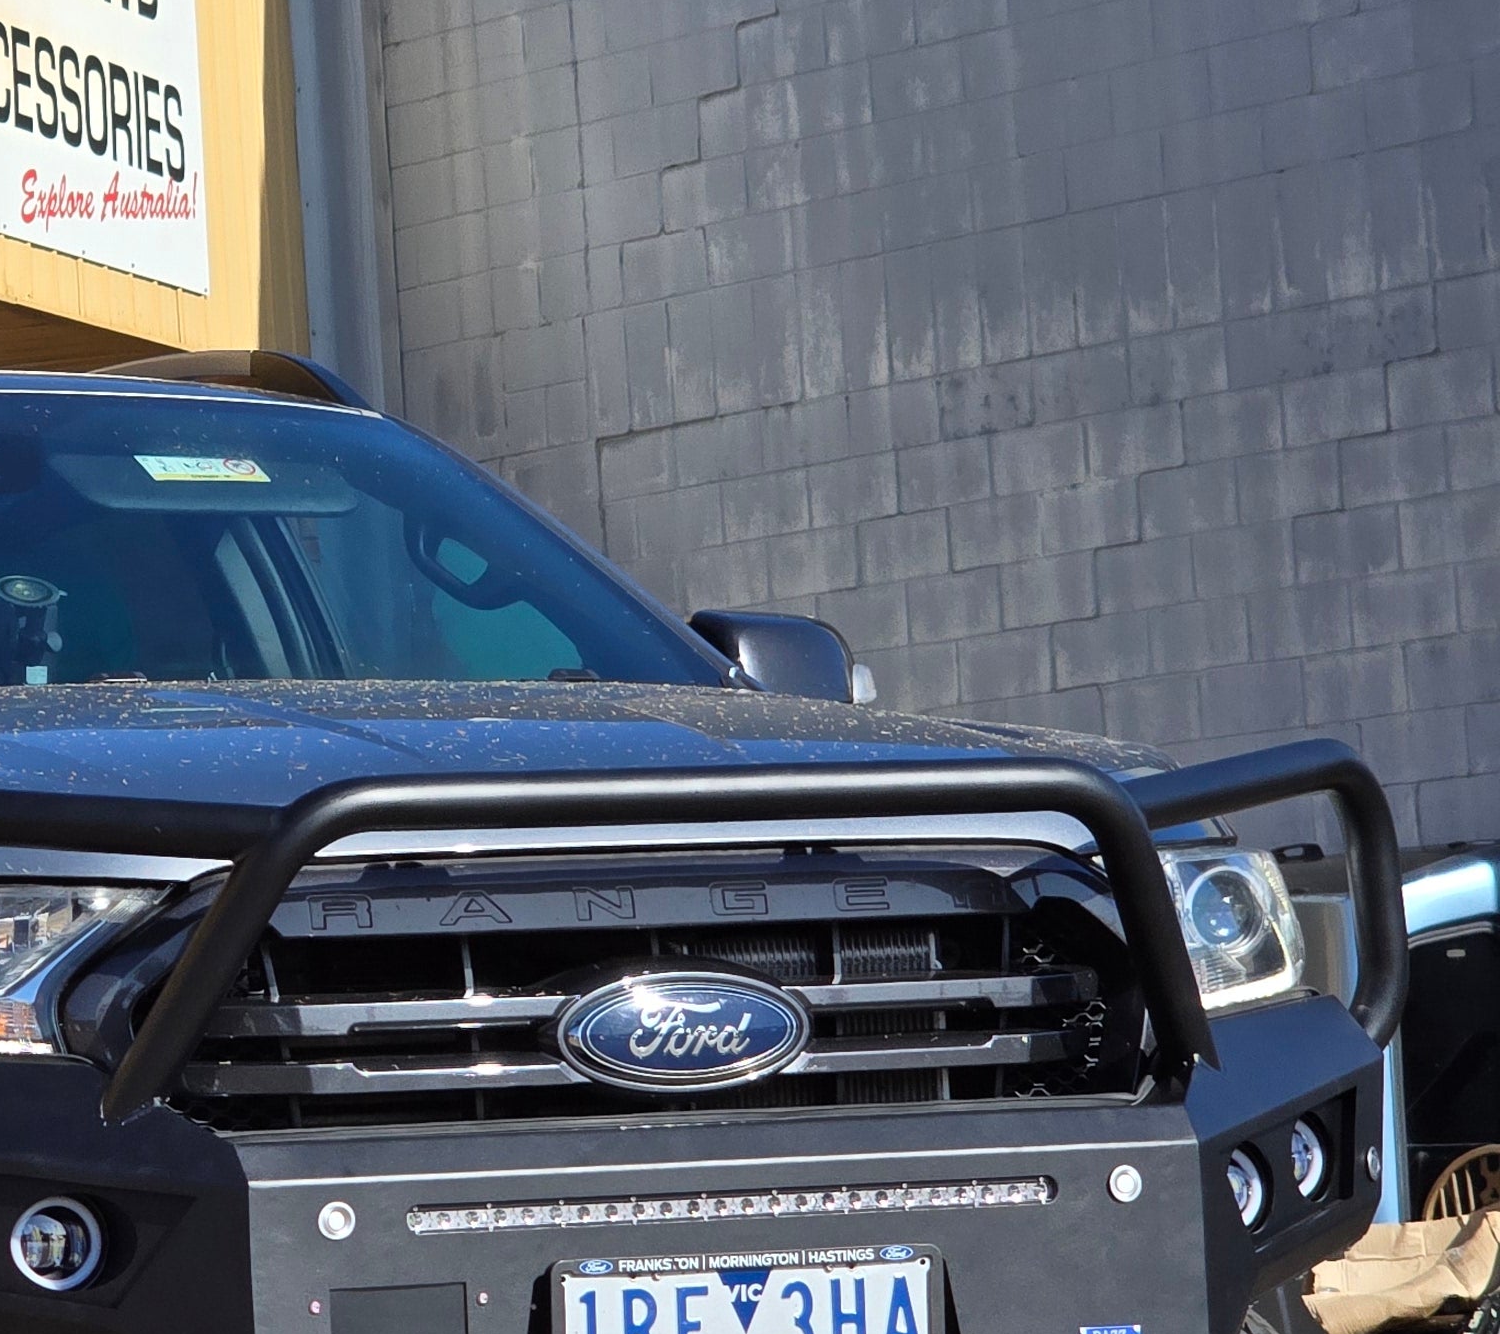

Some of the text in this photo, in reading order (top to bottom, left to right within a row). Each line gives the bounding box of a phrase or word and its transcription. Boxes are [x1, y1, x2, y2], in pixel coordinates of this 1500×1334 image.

[21, 168, 198, 233] Explore Australia!
[629, 1000, 752, 1059] Ford
[709, 1252, 799, 1269] MORNINGTON
[809, 1248, 875, 1263] HASTINGS
[726, 1283, 763, 1303] VIC
